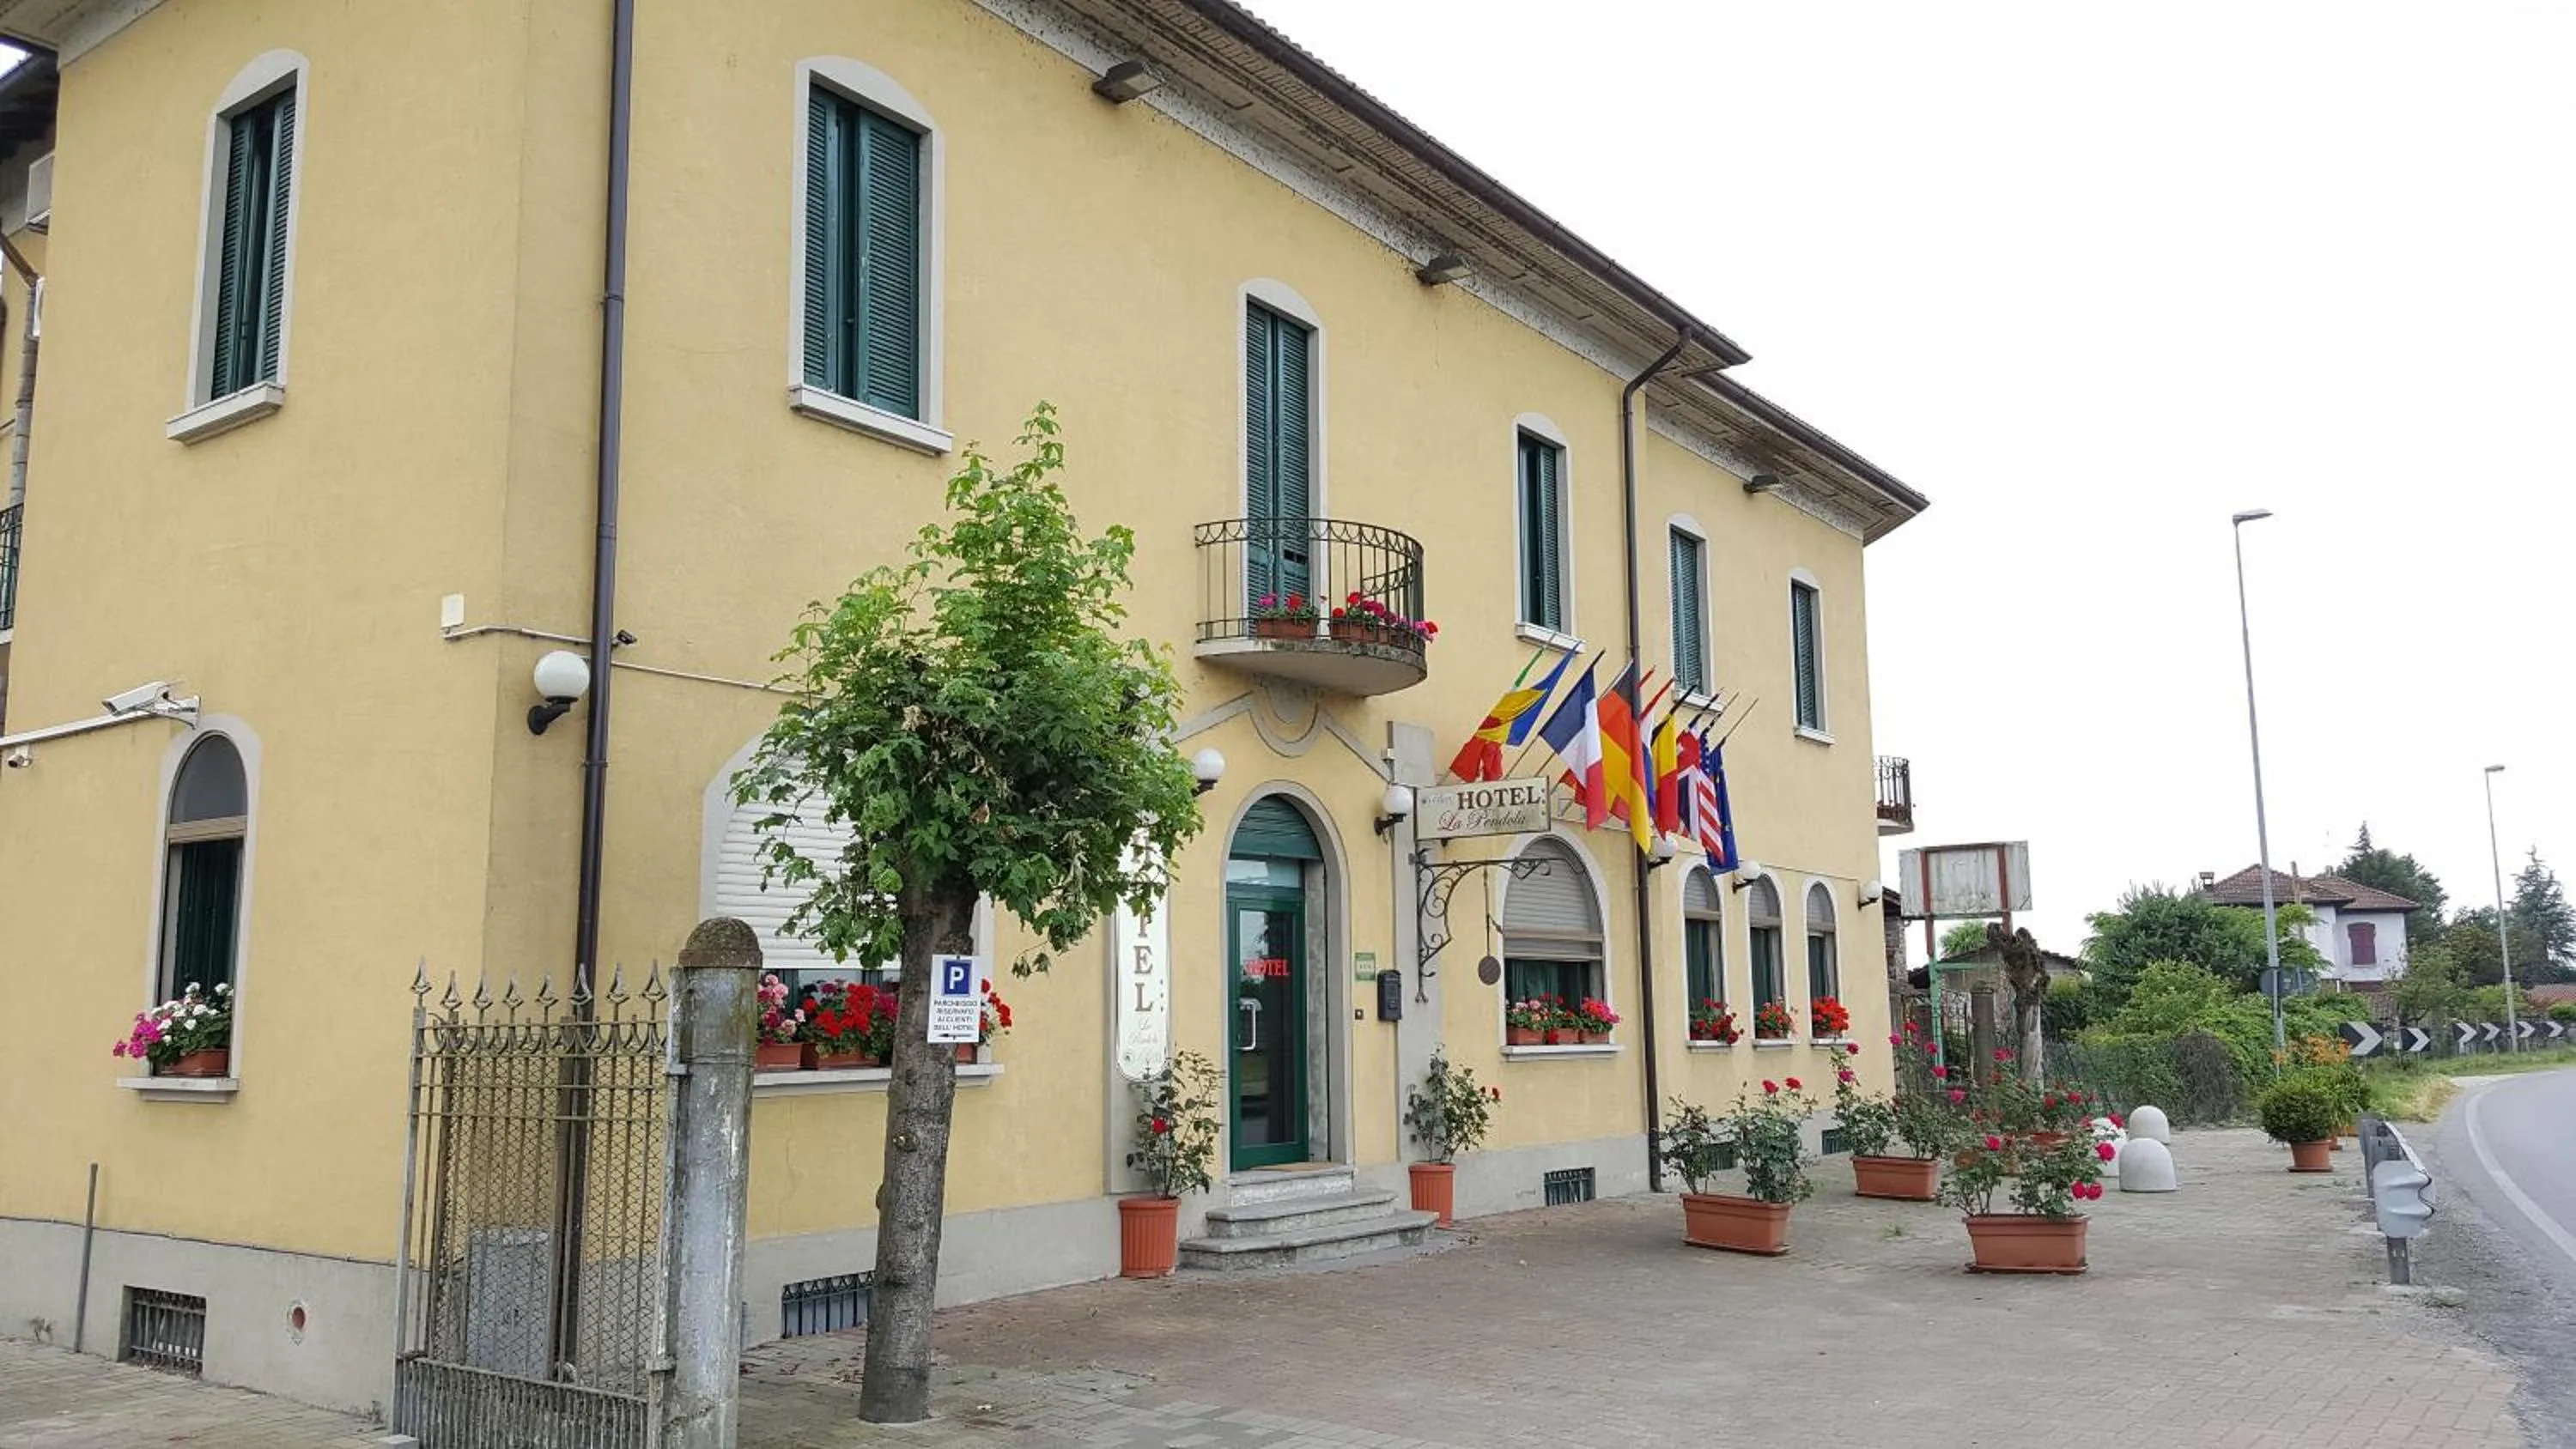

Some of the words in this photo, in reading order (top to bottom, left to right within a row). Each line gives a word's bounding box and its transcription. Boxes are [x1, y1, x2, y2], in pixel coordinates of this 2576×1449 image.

[1457, 785, 1540, 809] HOTEL
[1437, 810, 1461, 831] La
[1466, 808, 1527, 830] Pendola
[949, 966, 964, 990] P
